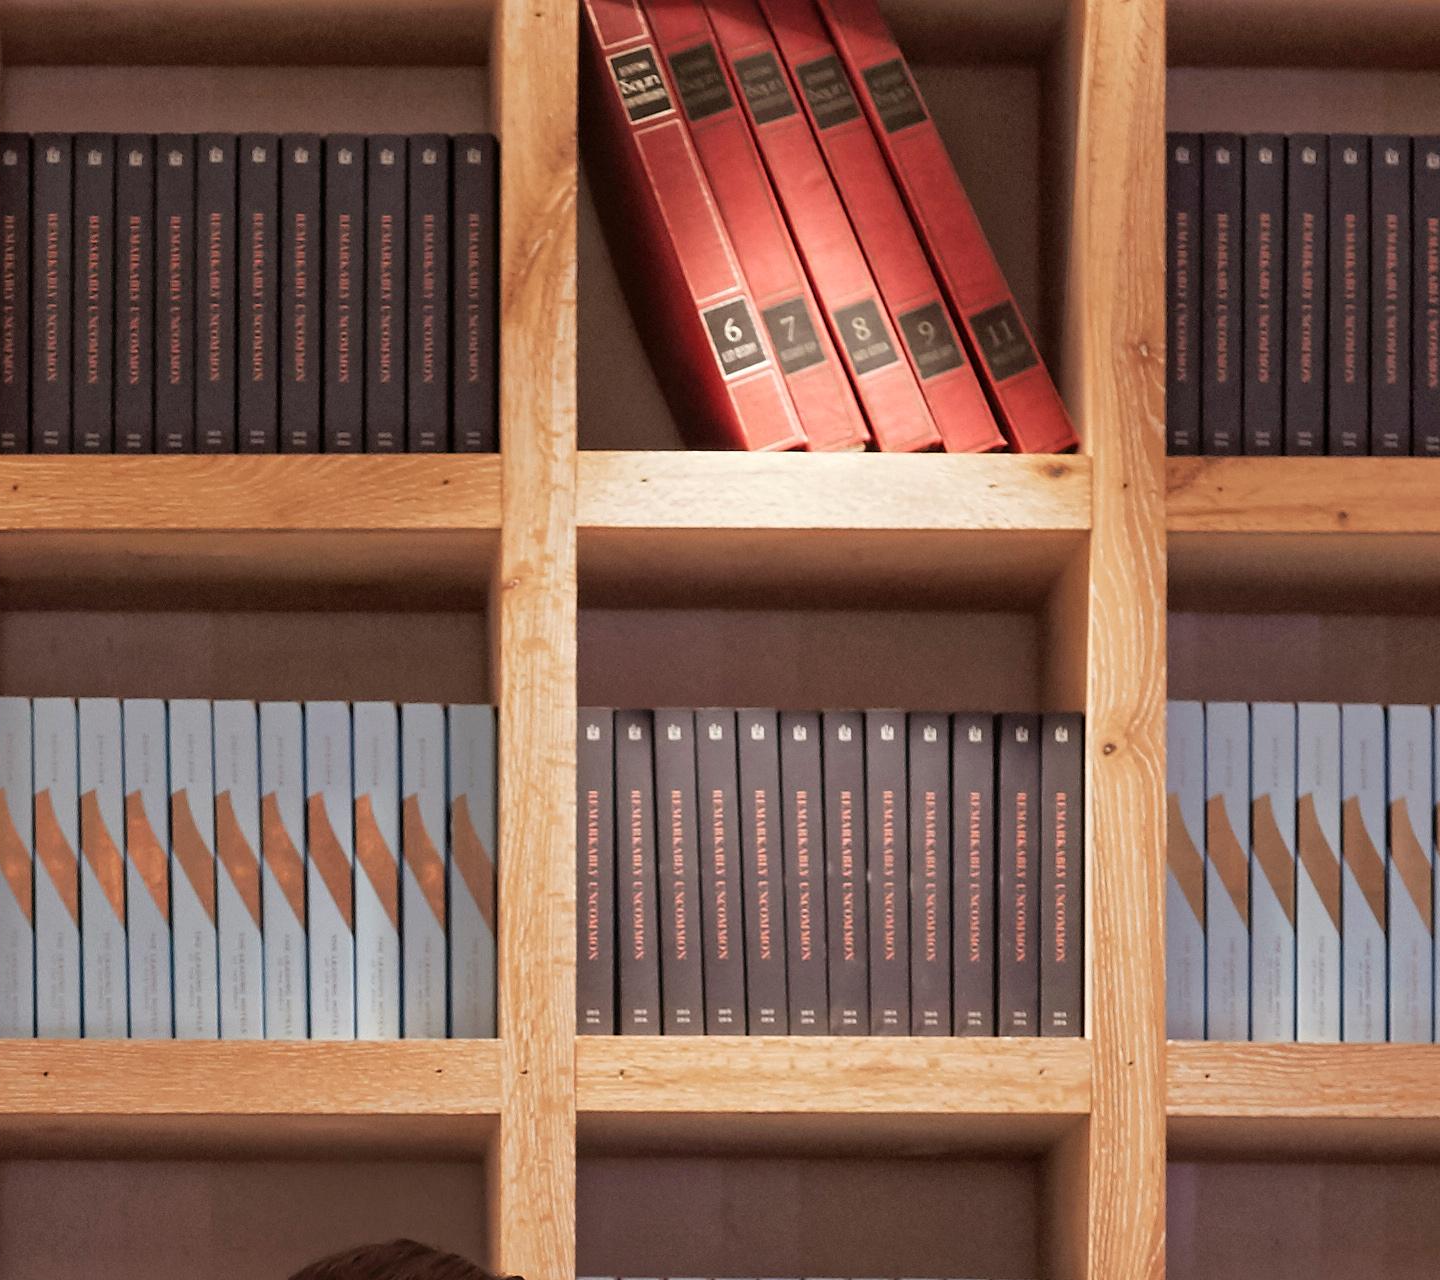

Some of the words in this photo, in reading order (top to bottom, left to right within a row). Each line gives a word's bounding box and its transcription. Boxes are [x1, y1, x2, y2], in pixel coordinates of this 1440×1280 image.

[723, 318, 743, 341] 6
[780, 316, 797, 342] 7
[918, 322, 936, 347] 9
